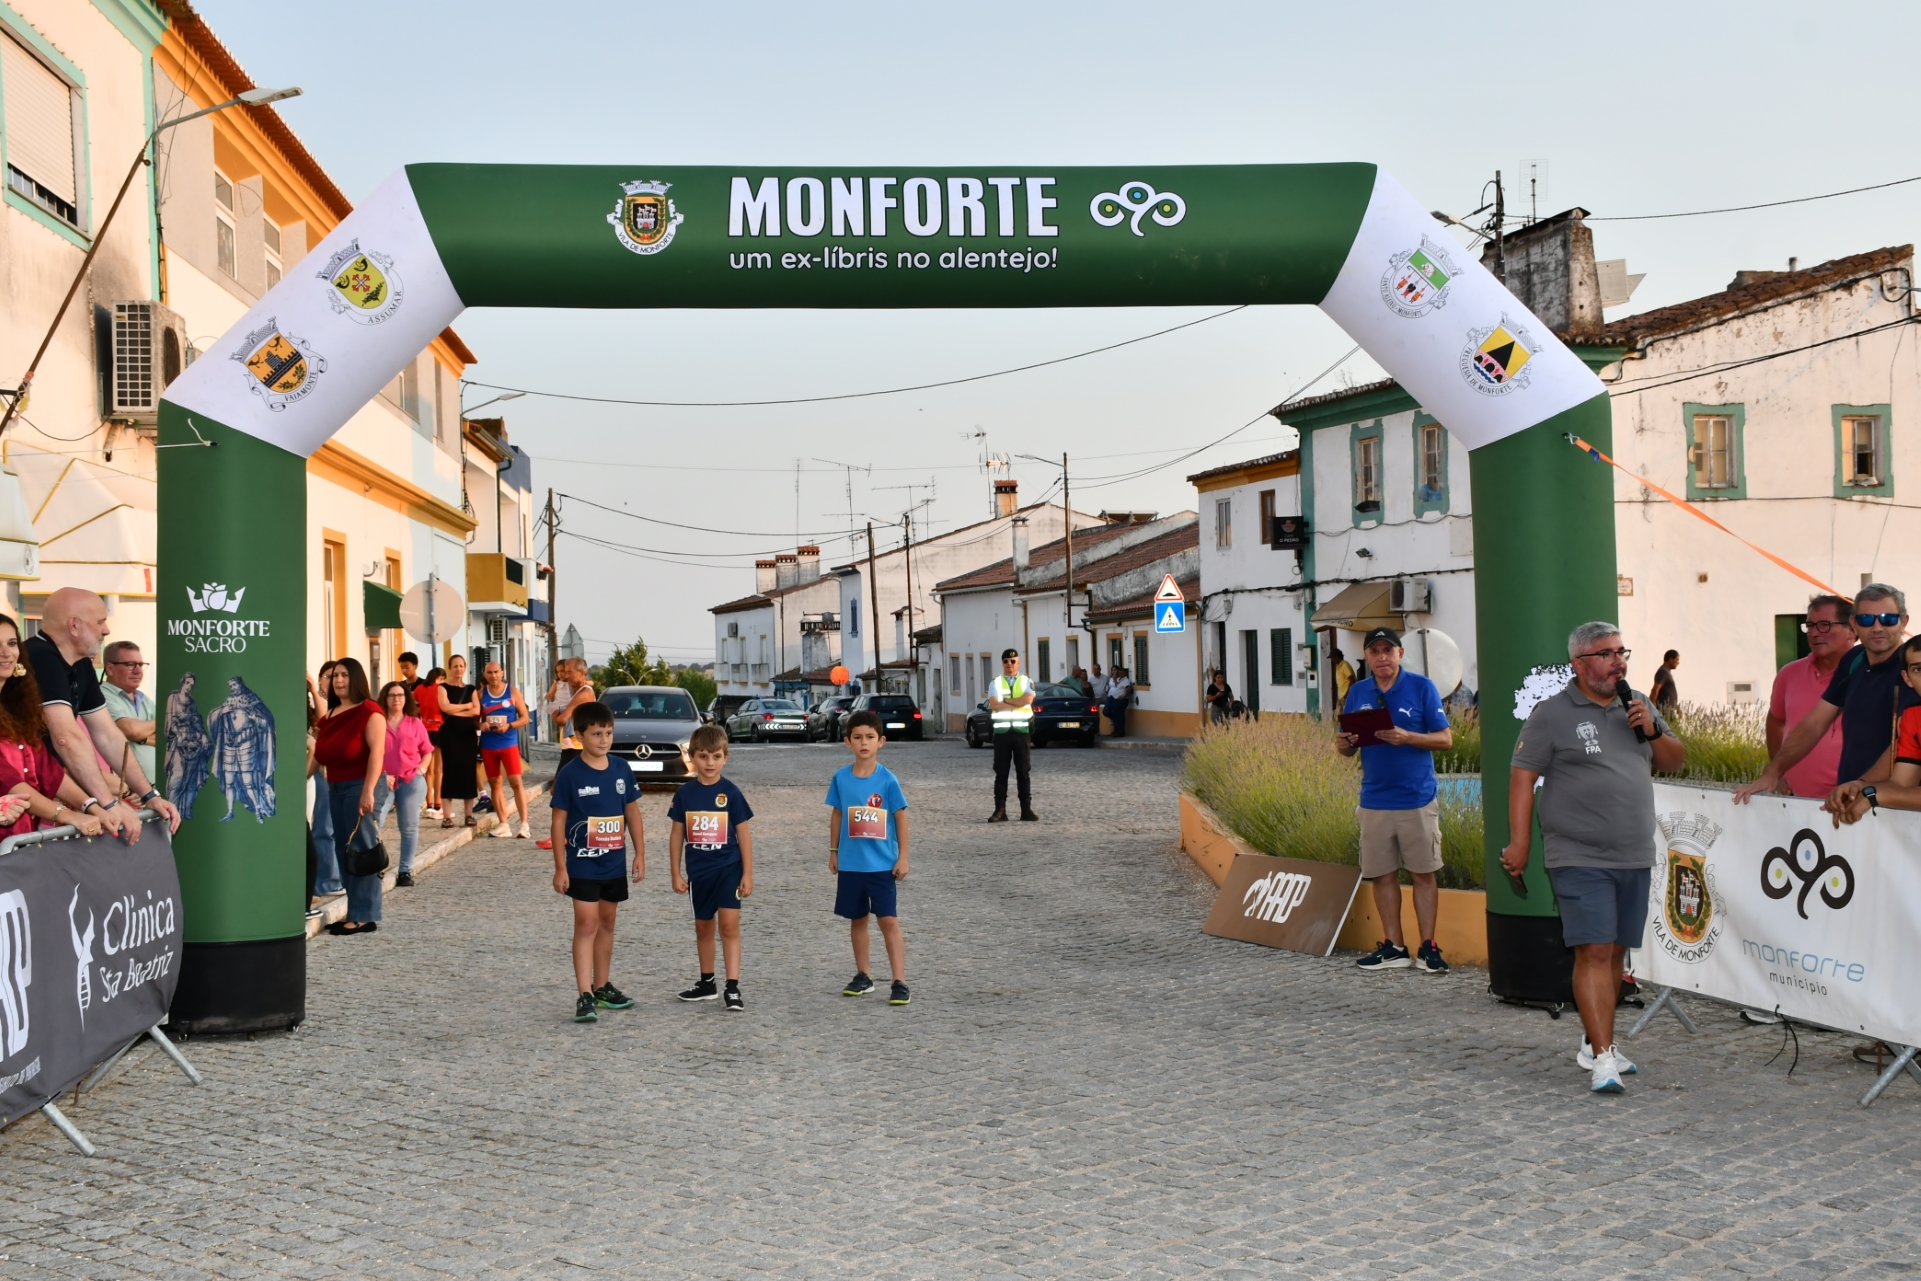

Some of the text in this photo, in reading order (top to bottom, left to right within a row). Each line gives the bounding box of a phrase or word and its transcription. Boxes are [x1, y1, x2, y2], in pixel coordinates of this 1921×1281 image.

[727, 176, 1059, 237] MONFORTE
[618, 232, 673, 254] VILA DE MONFORTE
[729, 245, 1058, 274] um ex-líbris no alentejo!
[367, 290, 402, 324] ASSUMAR
[1461, 346, 1512, 395] FREGUESIA DE MONFORTE
[284, 371, 317, 402] VAIAMONTE
[167, 619, 271, 637] MONFORTE
[184, 636, 247, 653] SACRO
[1585, 744, 1602, 755] FPA
[597, 820, 620, 834] 300
[691, 815, 719, 831] 284
[854, 809, 879, 824] 544
[1652, 915, 1720, 962] VILA DE MONFORTE
[100, 944, 174, 1003] Sta Beatriz
[1742, 938, 1865, 983] monforte
